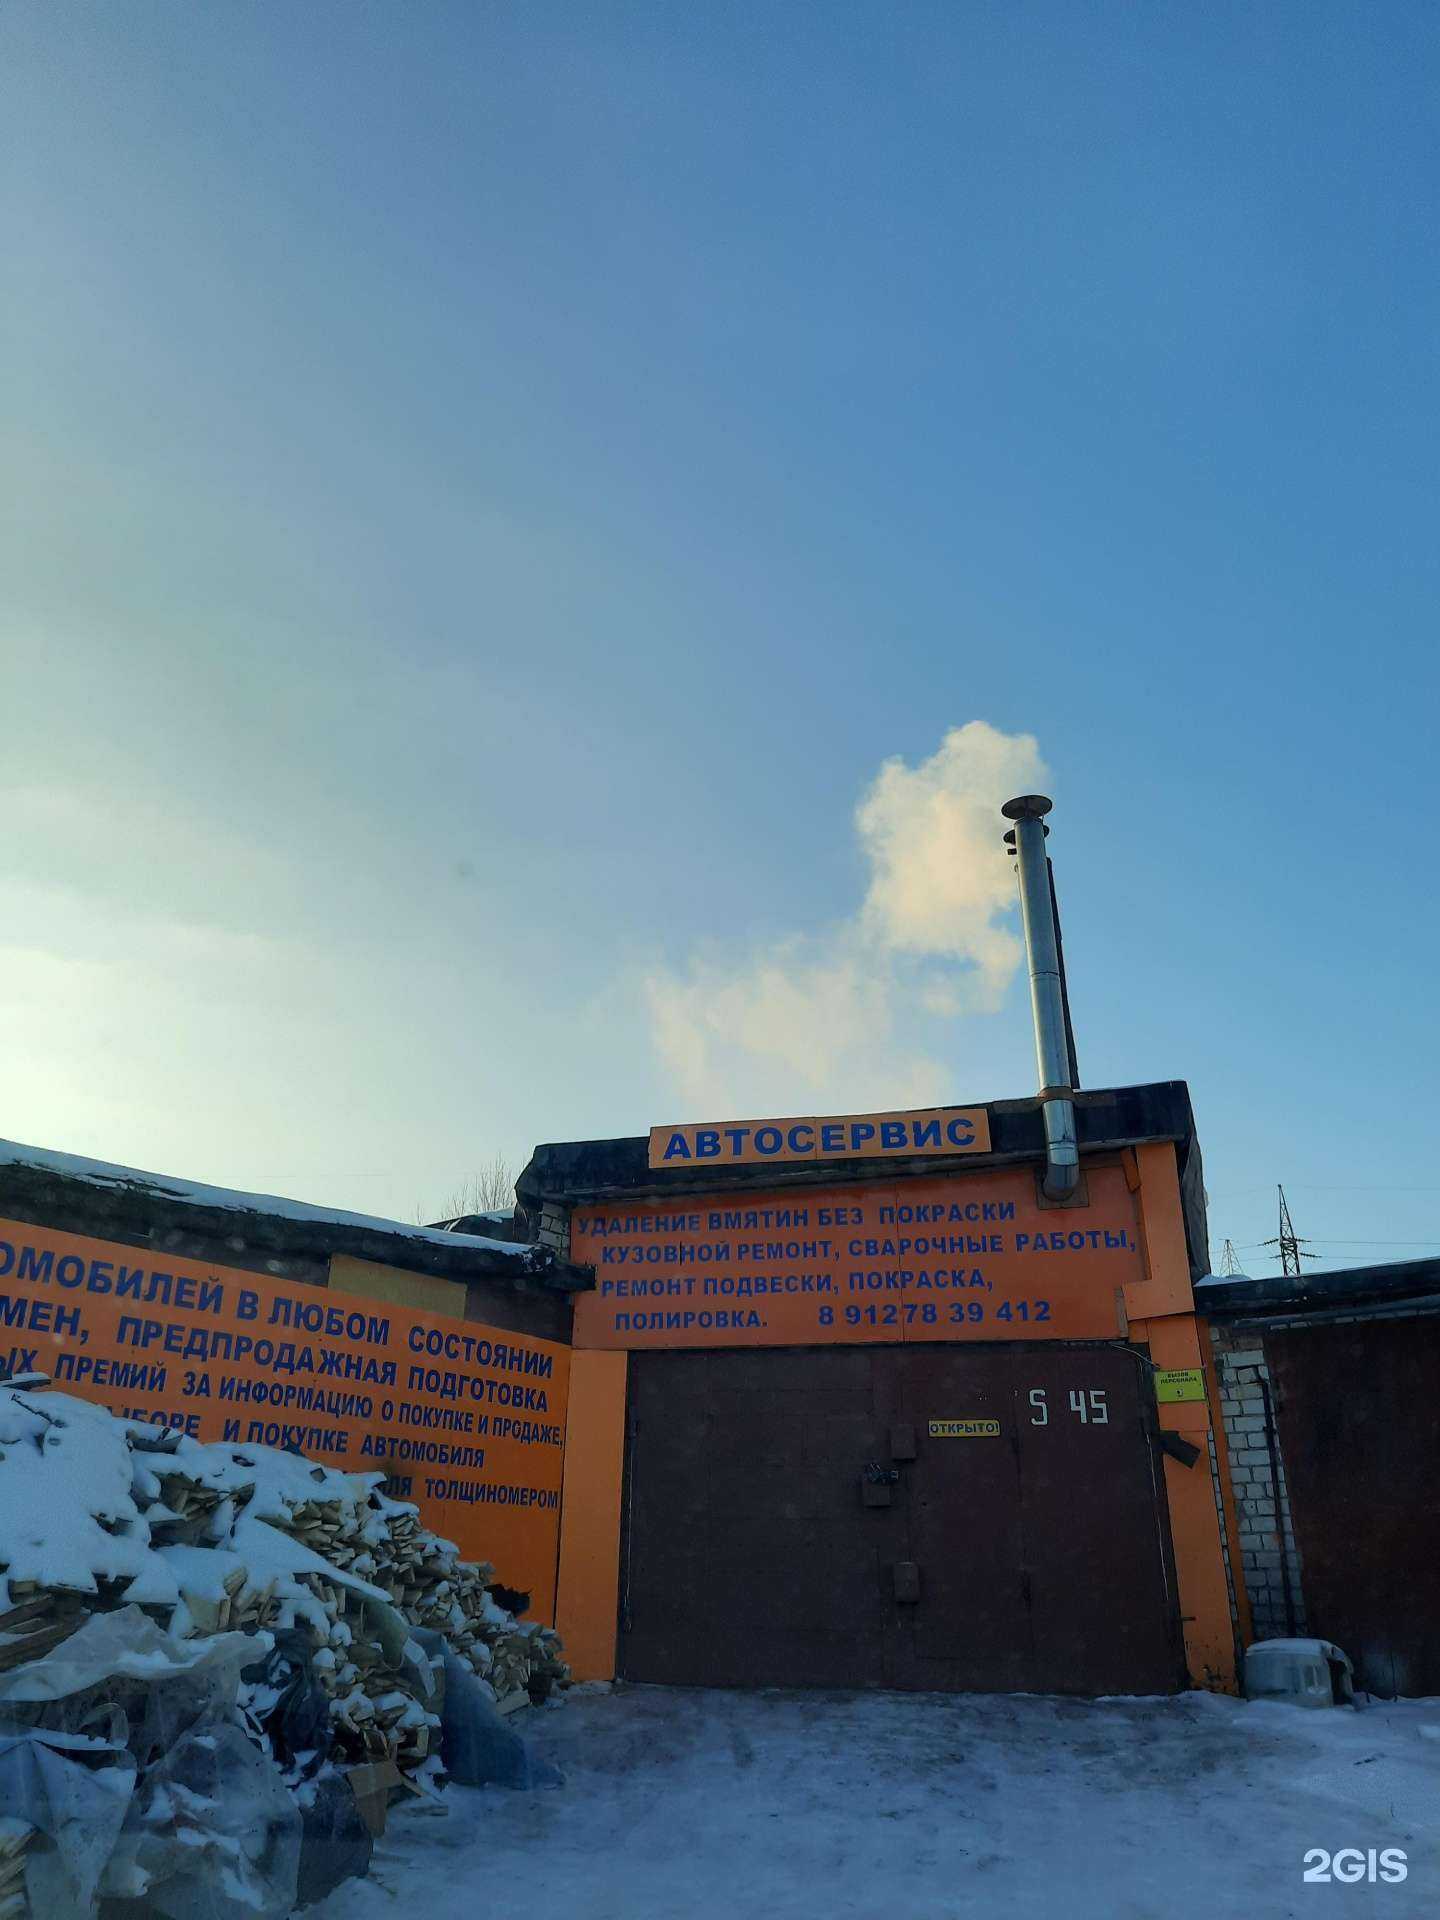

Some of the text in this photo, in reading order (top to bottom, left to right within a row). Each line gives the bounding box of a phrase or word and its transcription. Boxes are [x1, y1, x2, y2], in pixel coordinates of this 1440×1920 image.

[663, 1118, 976, 1160] АВТОСЕРВИС
[577, 1202, 1016, 1237] УДАЛЕНИЕ ВМЯТИН БЕЗ ПОКРАСКИ
[602, 1229, 1136, 1264] КУЗОВНОЙ РЕМОНТ, СВАРОЧНЫЕ РАБОТЫ,
[601, 1268, 993, 1298] РЕМОНТ ПОДВЕСКИ, ПОКРАСКА,
[614, 1309, 768, 1331] ПОЛИРОВКА.
[818, 1304, 834, 1325] 8
[949, 1301, 984, 1324] 39
[996, 1300, 1051, 1323] 412
[236, 1289, 259, 1321] В
[267, 1296, 390, 1346] ЛЮБОМ
[408, 1324, 553, 1379] СОСТОЯНИИ
[116, 1315, 397, 1386] ПРЕДПРОДАЖНАЯ
[408, 1366, 548, 1412] ПОДГОТОВКА
[54, 1353, 168, 1393] ПРЕМИЙ
[182, 1371, 211, 1398] ЗА
[219, 1376, 373, 1419] ИНФОРМАЦИЮ
[381, 1400, 394, 1422] О
[399, 1402, 474, 1434] ПОКУПКЕ
[477, 1414, 489, 1435] И
[492, 1417, 564, 1450] ПРОДАЖЕ,
[223, 1418, 241, 1442] И
[246, 1421, 348, 1456] ПОКУПКЕ
[360, 1434, 485, 1468] АВТОМОБИЛЯ
[930, 1422, 1000, 1434] ОТКРЫТО!
[425, 1477, 558, 1510] ТОЛЩИНОМЕРОМ
